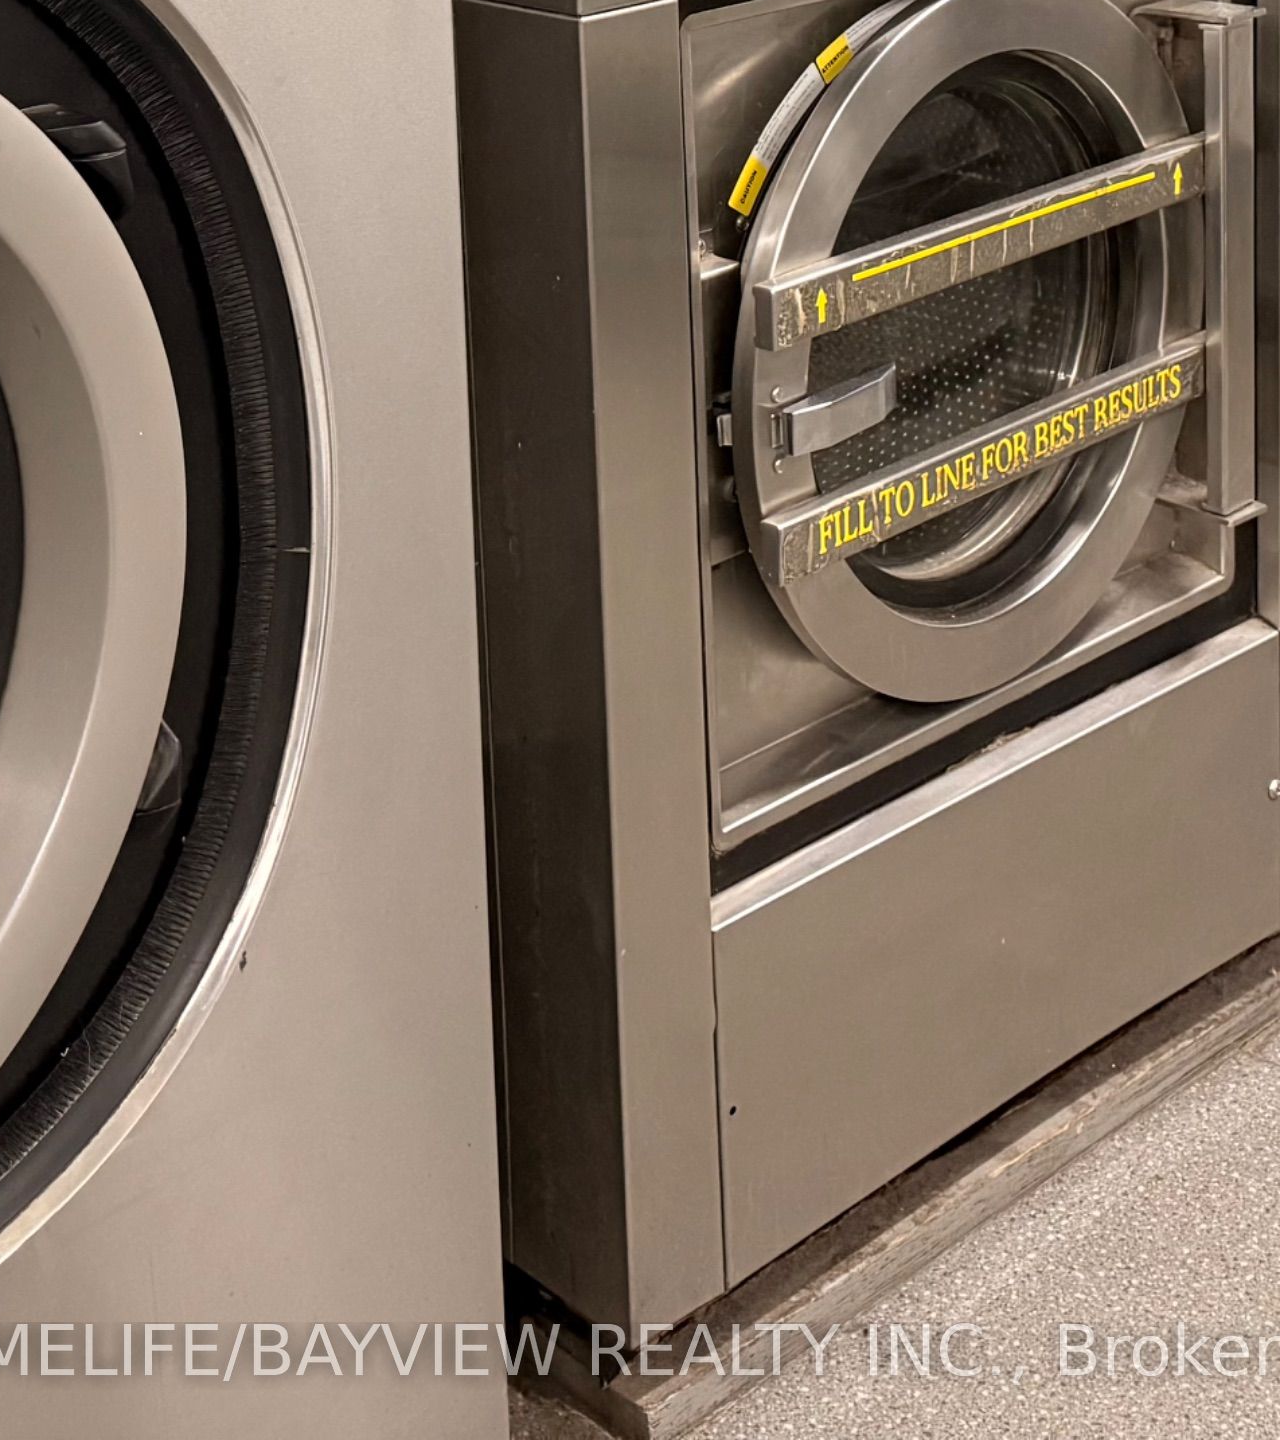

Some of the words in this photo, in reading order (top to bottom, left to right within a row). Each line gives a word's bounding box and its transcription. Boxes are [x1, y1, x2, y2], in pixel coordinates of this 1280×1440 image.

[822, 45, 849, 74] ATTENTION
[740, 170, 757, 204] CAUTION
[818, 498, 874, 555] FILL
[878, 482, 915, 524] TO
[919, 452, 976, 507] LINE
[980, 432, 1028, 482] FOR
[1033, 406, 1089, 458] BEST
[1092, 365, 1182, 428] RESULTS
